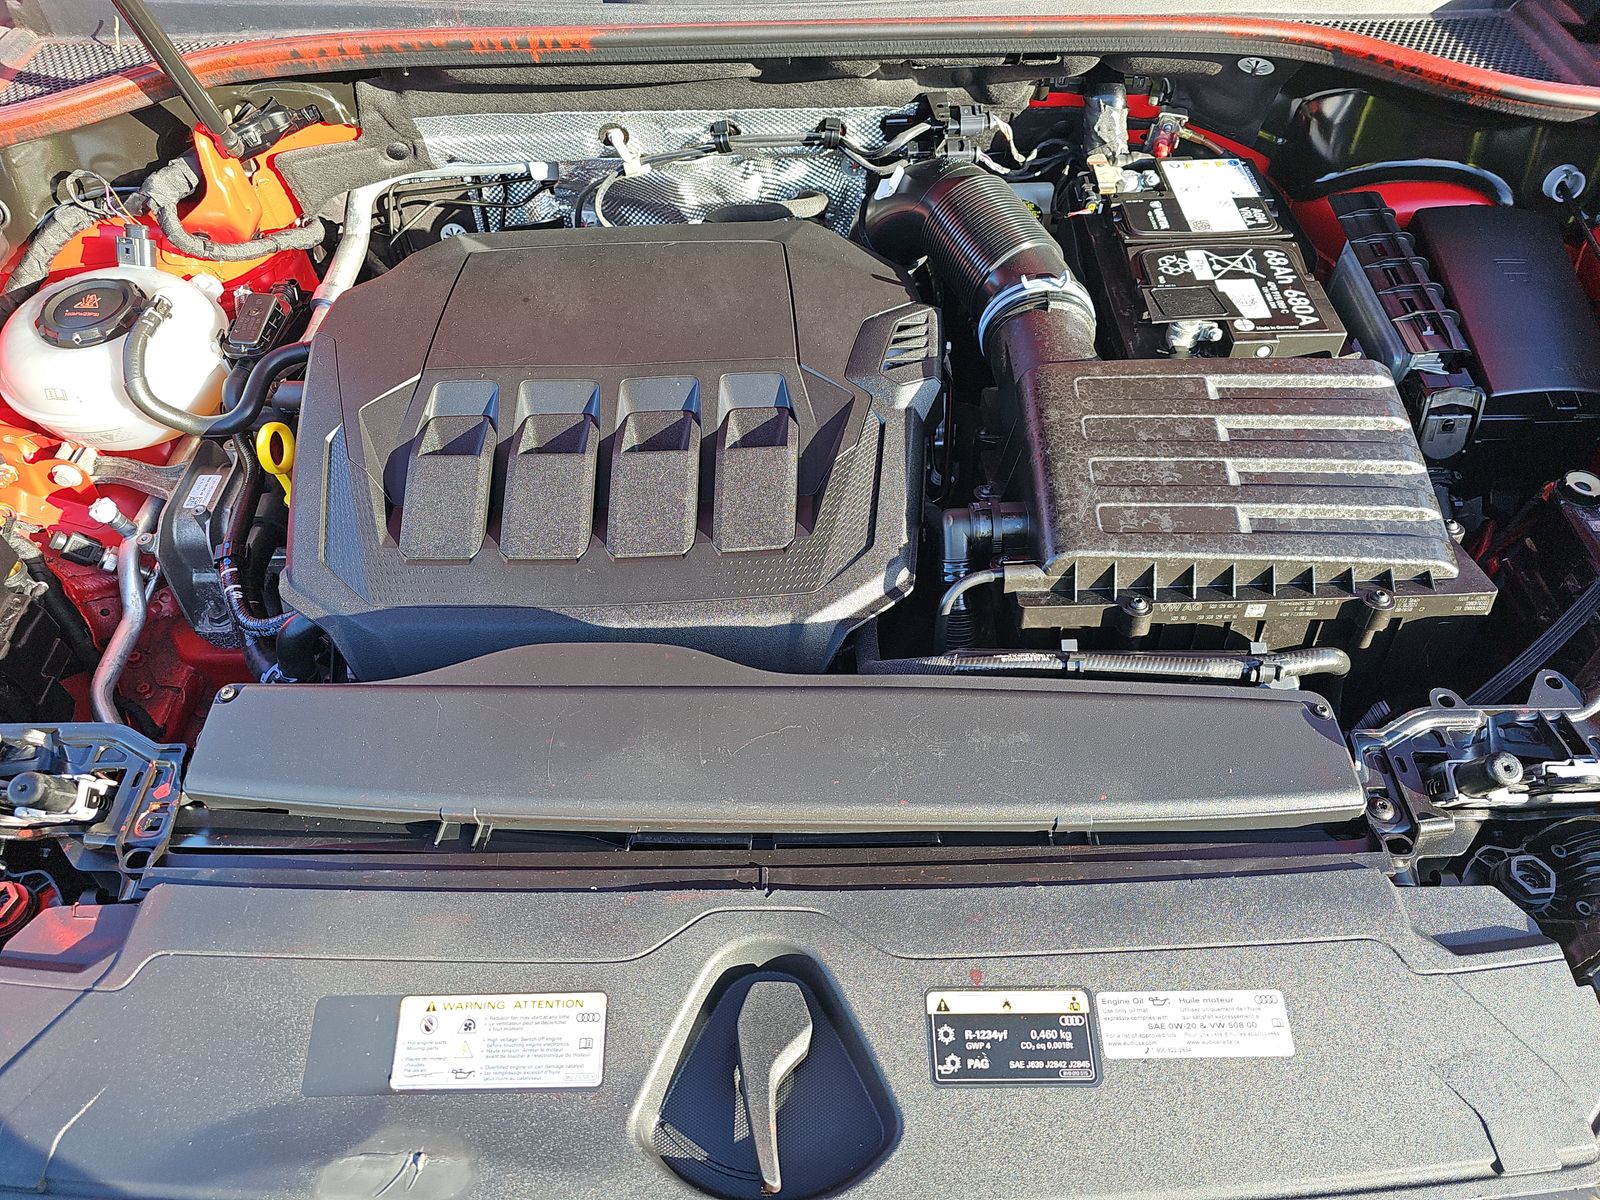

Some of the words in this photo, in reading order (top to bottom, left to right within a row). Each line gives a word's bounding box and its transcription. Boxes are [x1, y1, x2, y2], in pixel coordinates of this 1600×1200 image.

[1238, 206, 1256, 226] VRLA
[1263, 250, 1297, 284] 68Ah
[1283, 289, 1320, 326] 680A
[1160, 603, 1182, 612] VW
[1182, 603, 1203, 612] AG
[442, 1001, 506, 1010] WARNING
[514, 1000, 584, 1008] ATTENTION
[1102, 998, 1130, 1006] Engine
[964, 1029, 1008, 1042] R-1234yf
[1030, 1029, 1058, 1040] 0,460
[1060, 1029, 1072, 1041] kg
[967, 1058, 990, 1069] PAG
